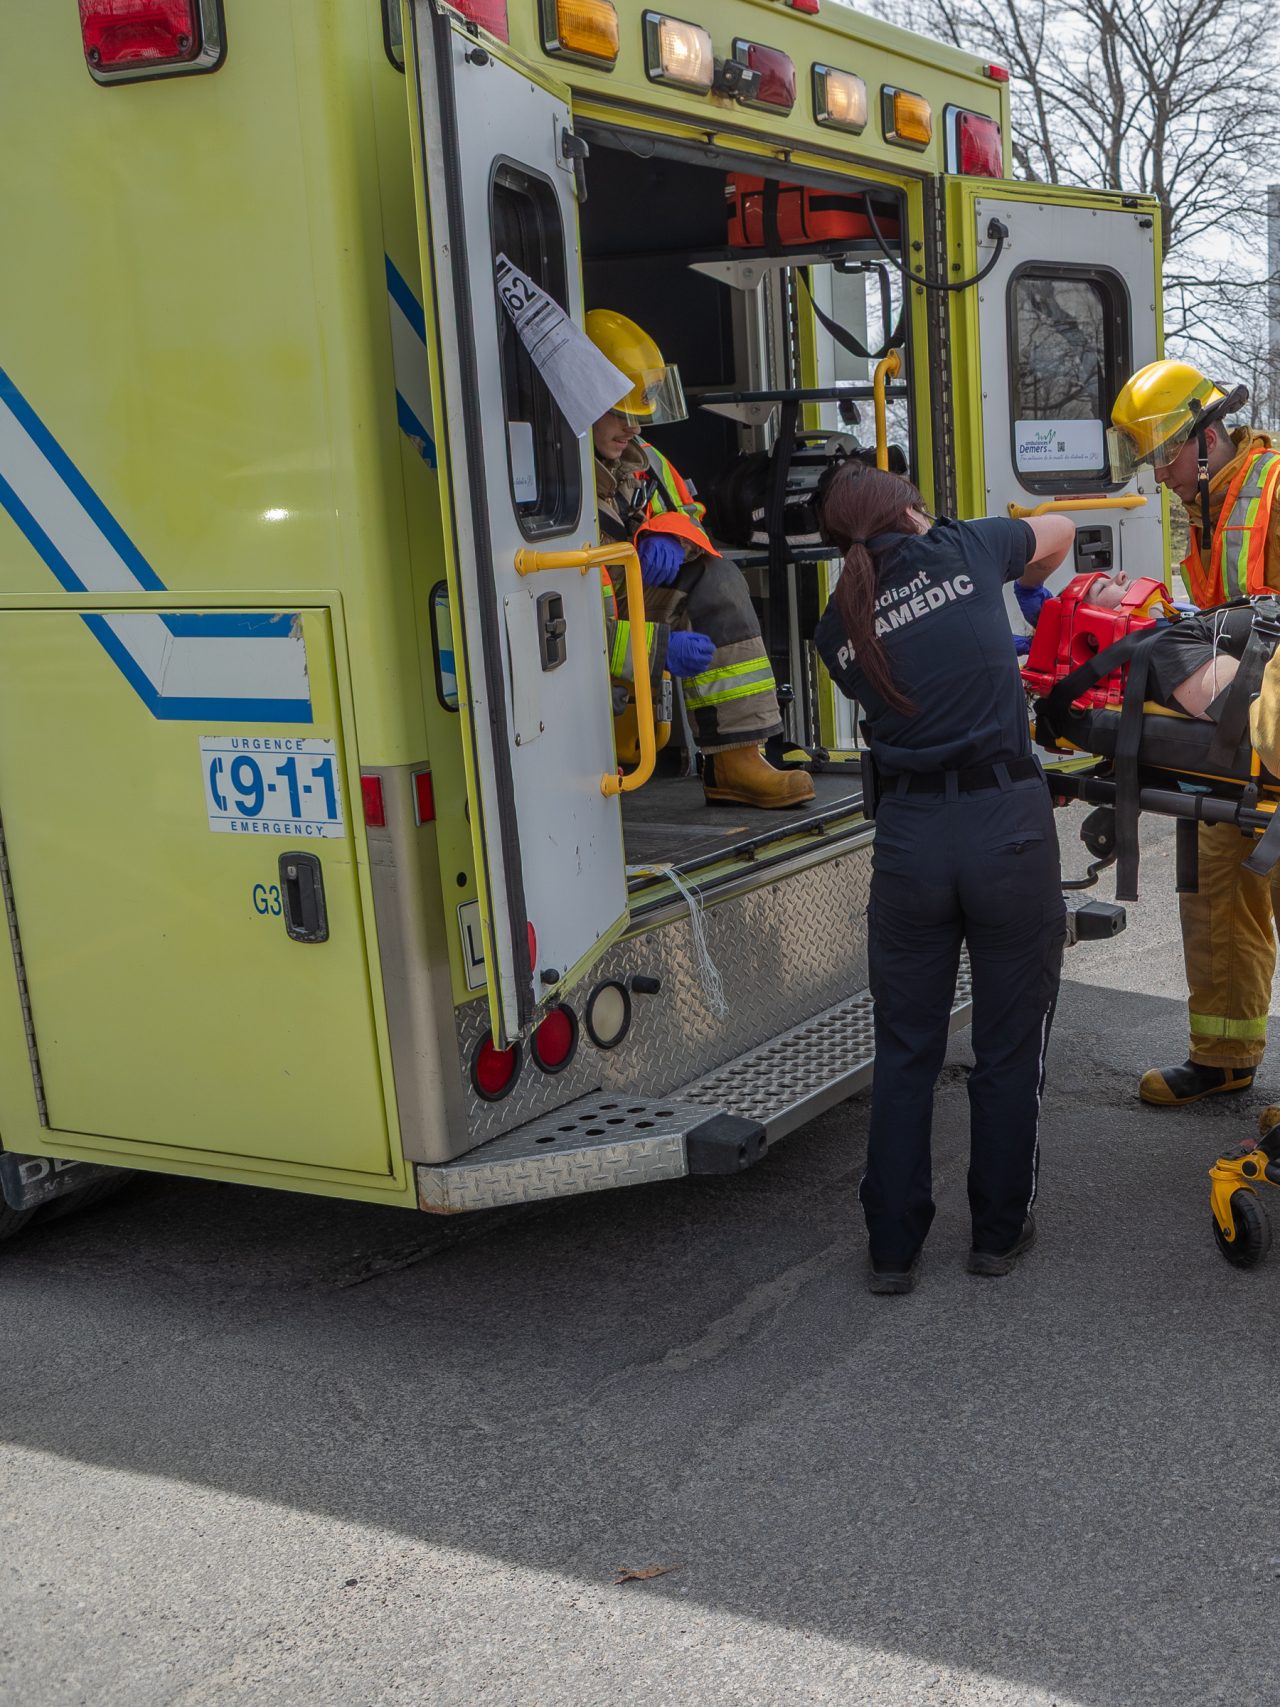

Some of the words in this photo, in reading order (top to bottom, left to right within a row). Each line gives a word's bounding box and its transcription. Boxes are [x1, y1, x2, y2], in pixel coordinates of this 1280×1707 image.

[1019, 444, 1048, 454] Demers
[836, 574, 975, 671] PAMÉDIC
[231, 738, 304, 751] URGENCE
[230, 755, 338, 820] 9-1-1
[230, 820, 324, 836] EMERGENCY
[252, 883, 283, 916] G3
